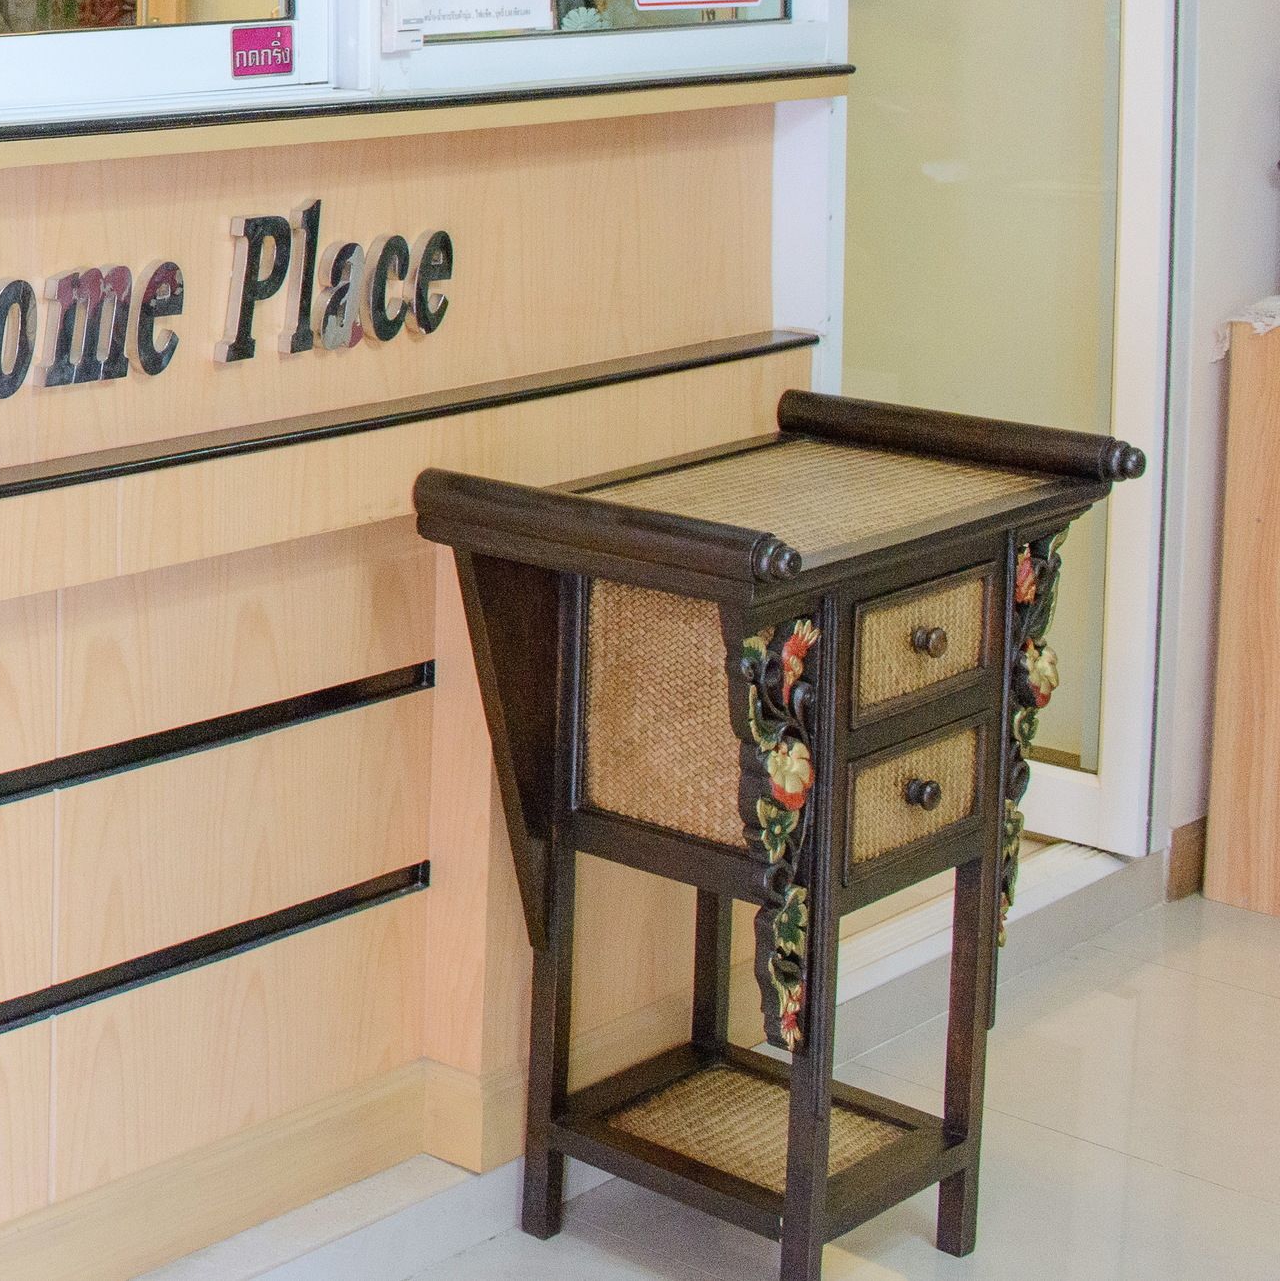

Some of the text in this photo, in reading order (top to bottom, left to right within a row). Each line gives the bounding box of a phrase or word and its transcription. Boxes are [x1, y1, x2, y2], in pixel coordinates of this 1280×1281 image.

[235, 31, 290, 68] กดกริ่ง
[218, 199, 455, 363] Place
